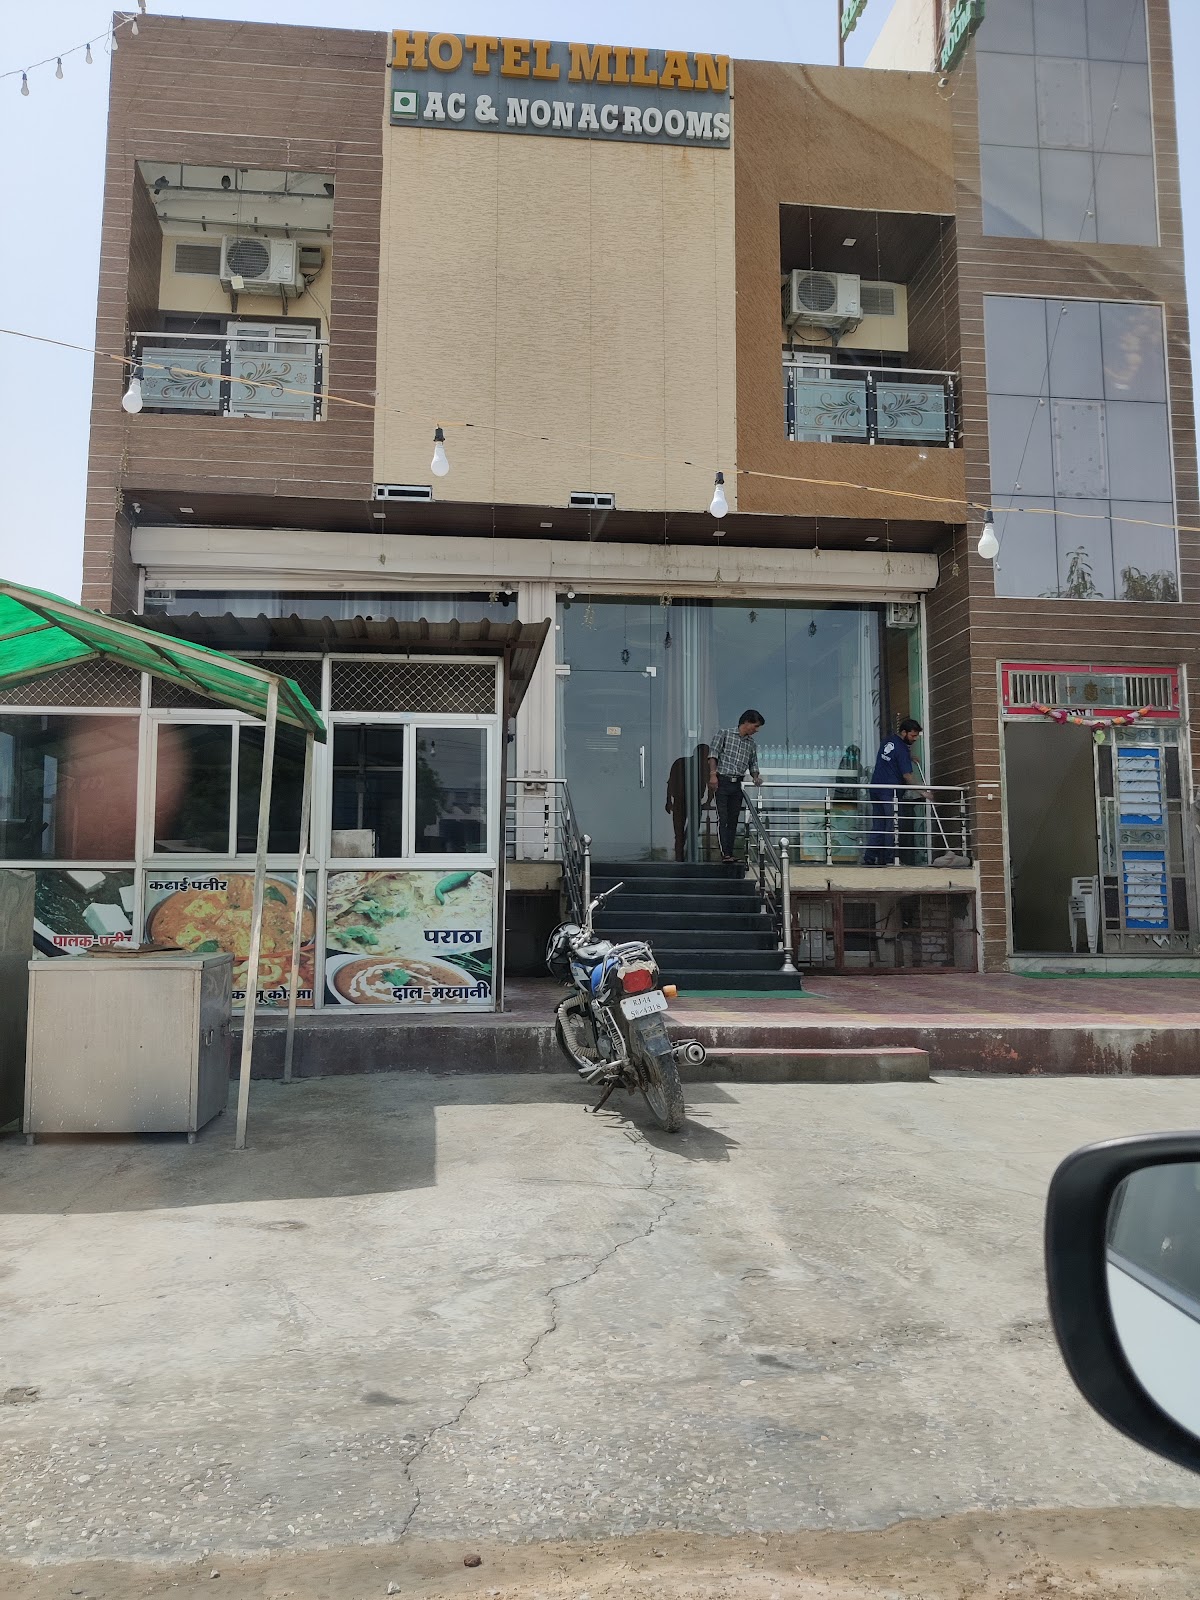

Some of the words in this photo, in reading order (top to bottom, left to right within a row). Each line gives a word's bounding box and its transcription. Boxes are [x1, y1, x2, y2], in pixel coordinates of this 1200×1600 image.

[392, 29, 560, 81] HOTEL
[568, 42, 730, 93] MILAN
[423, 91, 466, 122] AC
[474, 94, 499, 124] &
[192, 877, 227, 891] पनीर
[424, 929, 482, 944] पराठा
